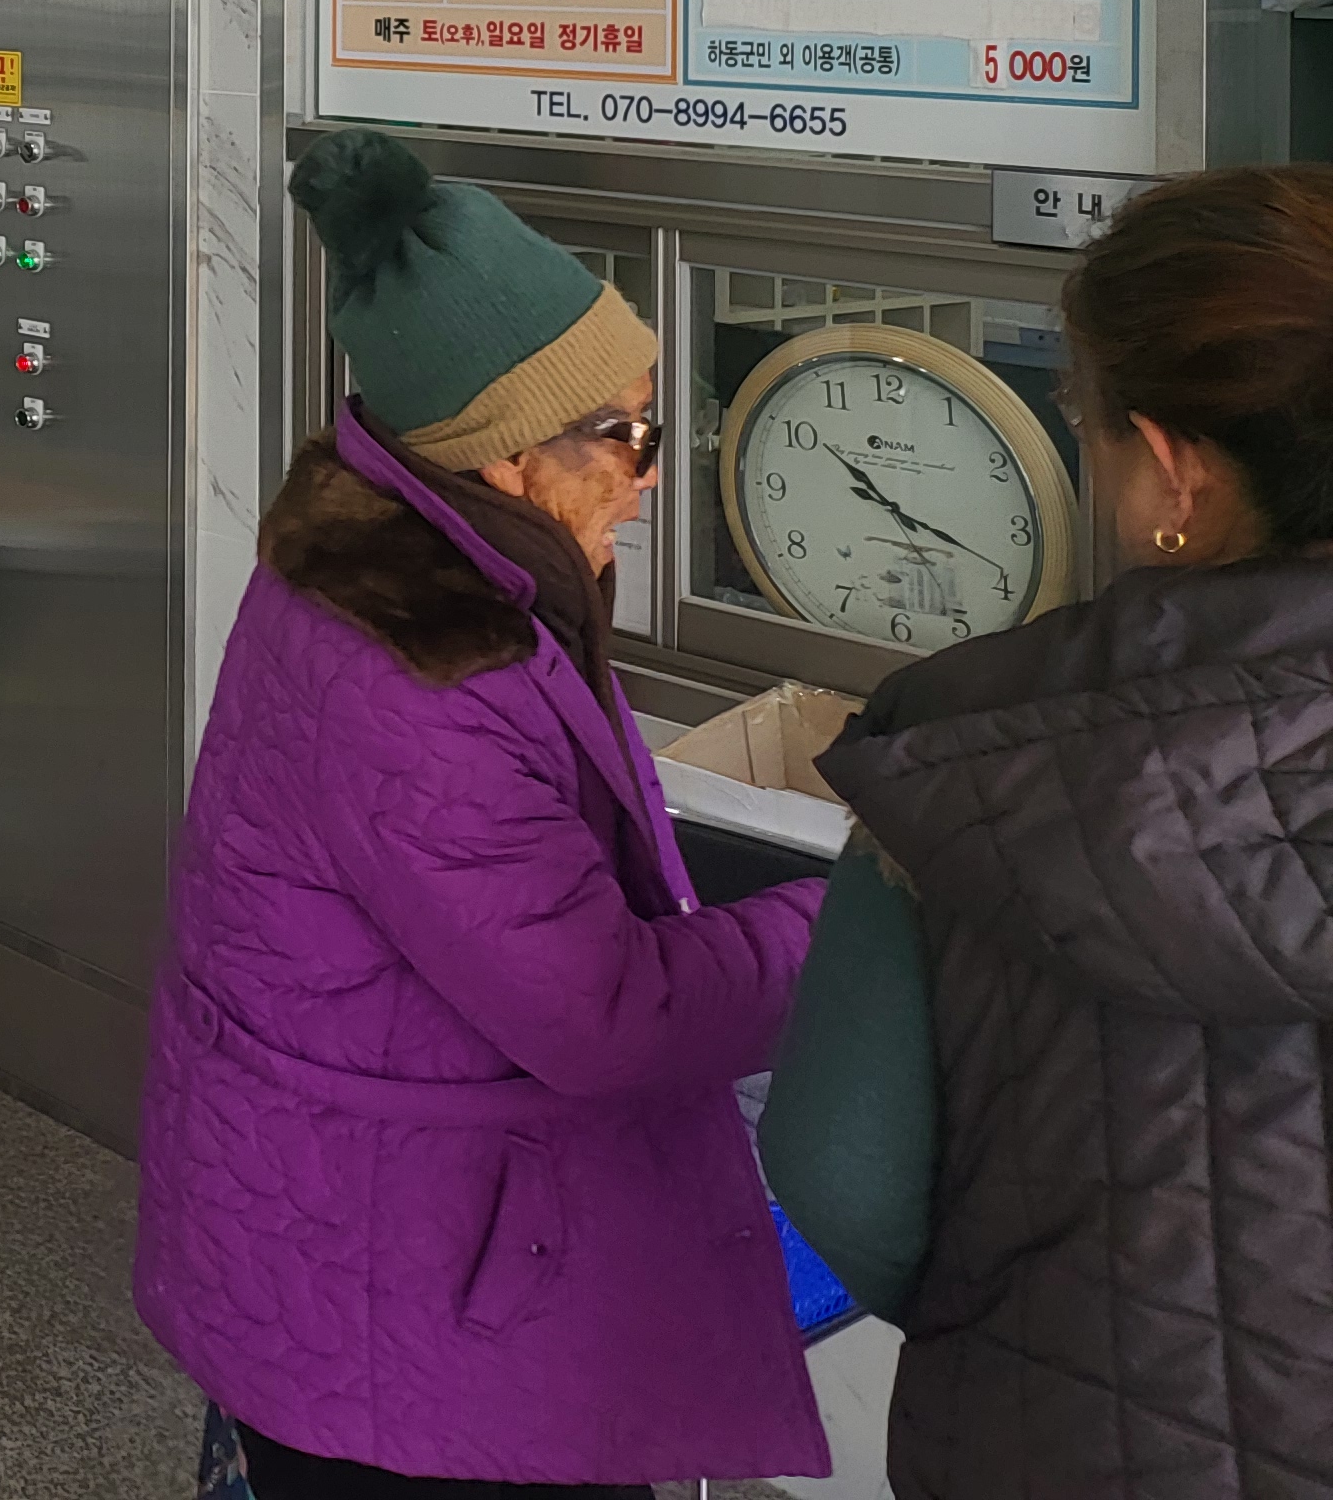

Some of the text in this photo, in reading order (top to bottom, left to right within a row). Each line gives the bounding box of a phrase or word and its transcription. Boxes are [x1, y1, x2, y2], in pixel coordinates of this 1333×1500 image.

[374, 16, 411, 44] 매주
[557, 21, 644, 54] 정기휴일
[707, 39, 772, 70] 하동군민
[778, 42, 795, 71] 외
[802, 41, 901, 77] 이용객(공통)
[530, 89, 847, 137] TEL. 070-8994-6655
[821, 379, 851, 411] 11
[870, 373, 906, 405] 12
[944, 396, 959, 427] 1
[782, 419, 818, 452] 10
[988, 451, 1010, 483] 2
[765, 472, 787, 502] 9
[786, 529, 808, 560] 8
[1010, 515, 1032, 546] 3
[834, 584, 856, 613] 7
[991, 573, 1016, 601] 4
[890, 612, 913, 643] 6
[951, 608, 973, 639] 5
